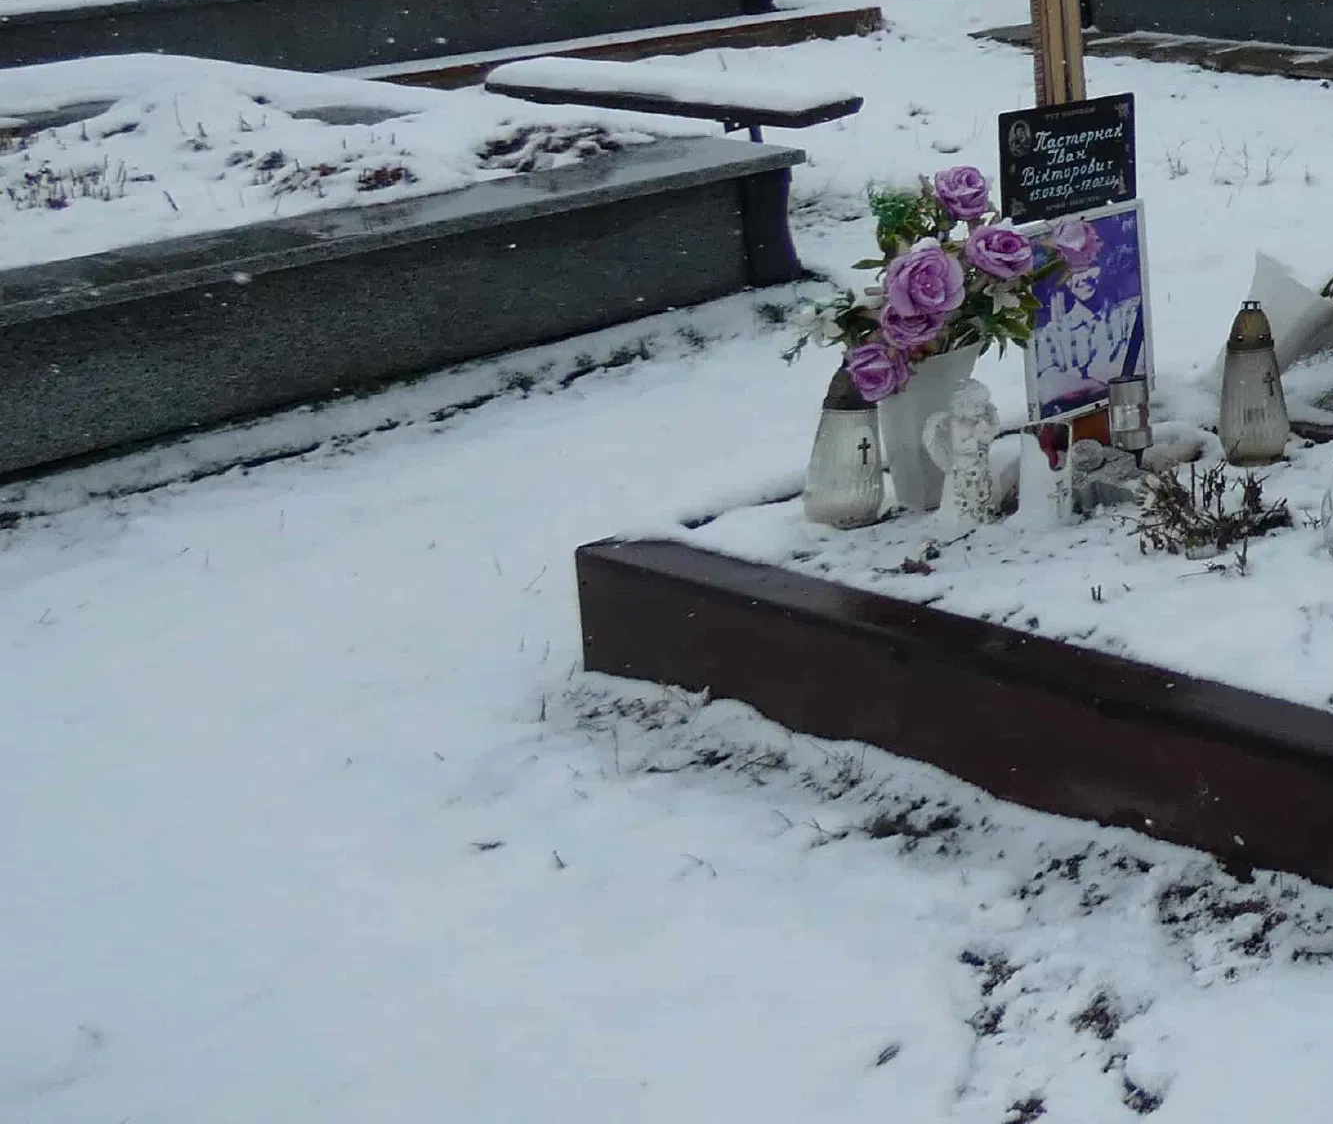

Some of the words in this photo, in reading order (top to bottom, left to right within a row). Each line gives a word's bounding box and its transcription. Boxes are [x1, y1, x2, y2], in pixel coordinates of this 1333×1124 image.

[1033, 122, 1123, 152] Пастернак
[1047, 148, 1087, 165] Іван
[1020, 157, 1114, 187] Вікторович
